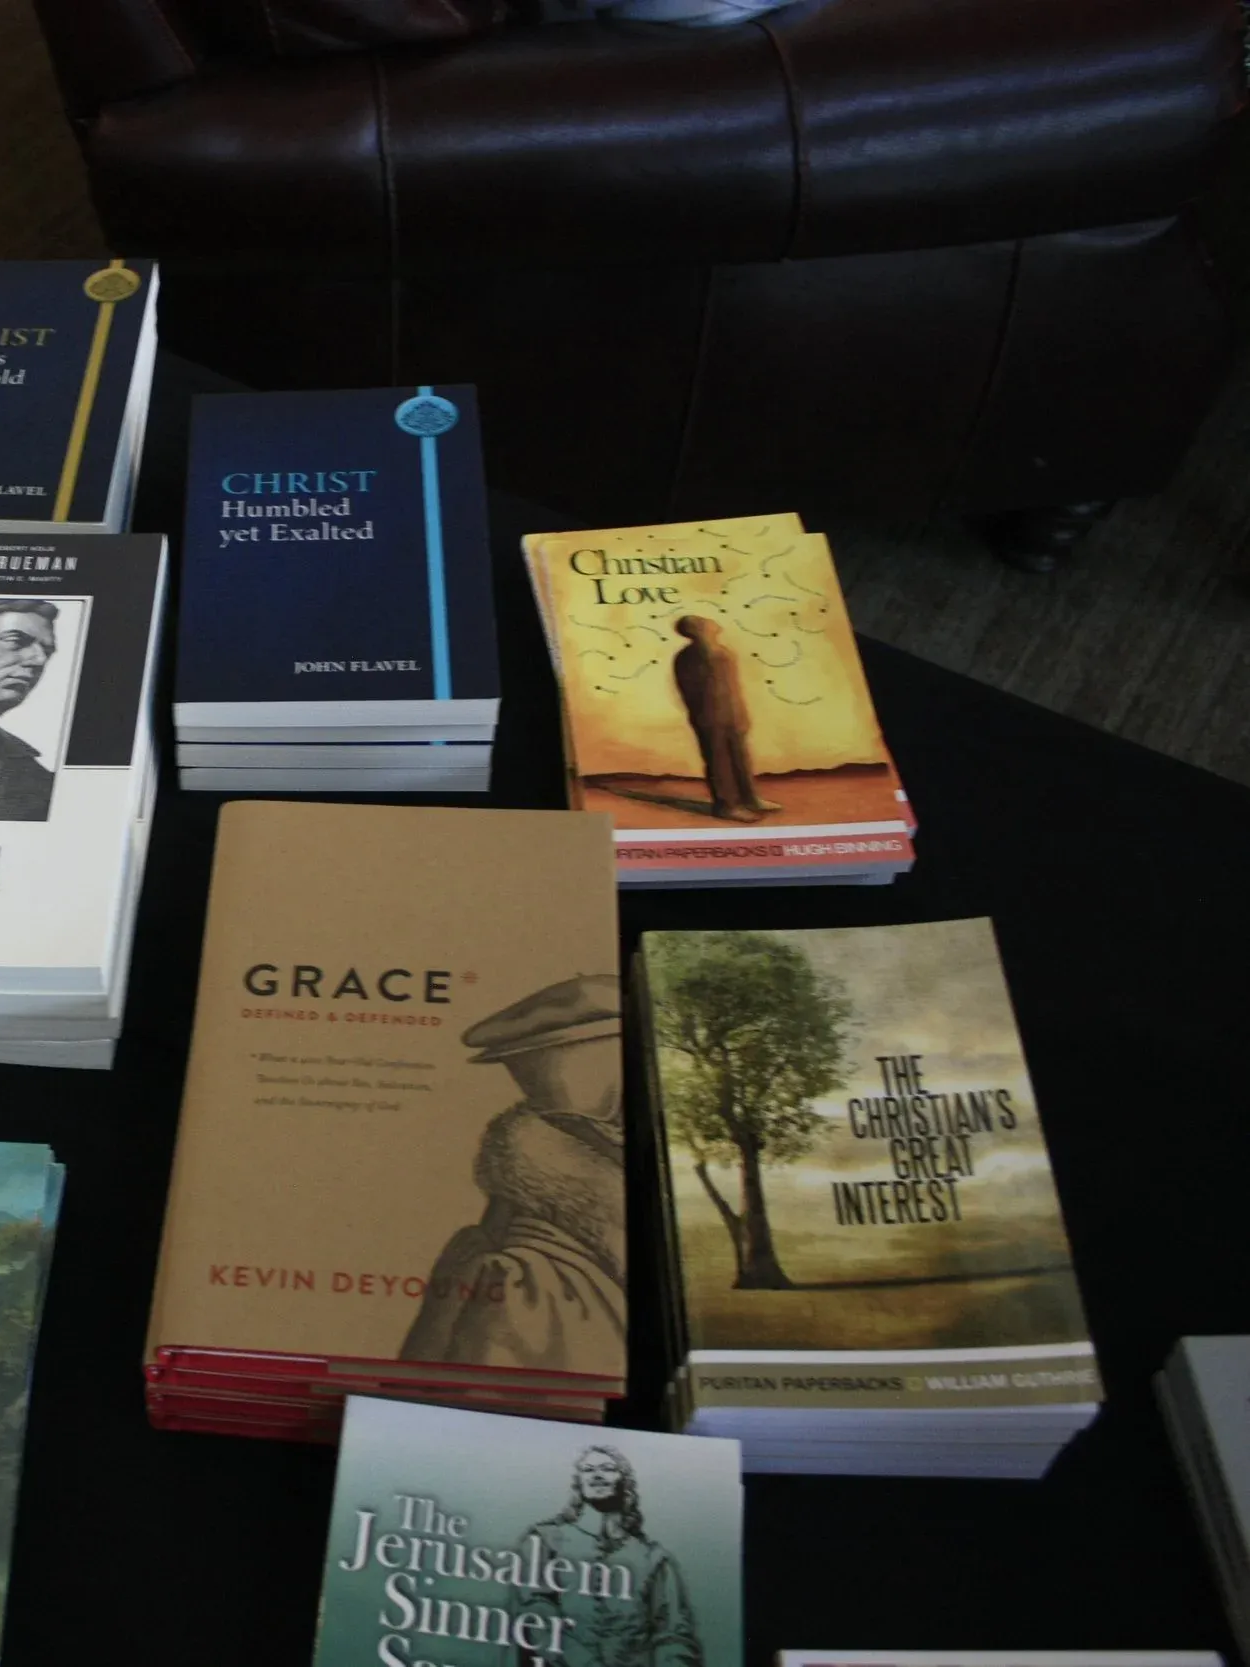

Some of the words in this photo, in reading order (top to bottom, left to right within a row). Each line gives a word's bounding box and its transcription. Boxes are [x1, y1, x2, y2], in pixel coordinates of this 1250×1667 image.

[220, 469, 378, 495] CHRIST
[220, 497, 352, 519] Humbled
[218, 525, 261, 549] yet
[269, 520, 375, 542] Exalted
[569, 548, 723, 576] Christian
[593, 578, 681, 606] Love
[293, 661, 346, 674] JOHN
[349, 659, 421, 672] FLAVEL
[242, 963, 453, 1005] GRACE
[239, 1007, 321, 1022] DEFINED
[326, 1011, 337, 1024] &
[343, 1012, 444, 1027] DEFENDED
[875, 1054, 924, 1097] THE
[848, 1088, 1017, 1139] CHRISTIAN'S
[888, 1133, 976, 1181] GREAT
[831, 1178, 964, 1226] INTEREST
[209, 1264, 316, 1292] KEVIN
[699, 1376, 777, 1392] PURITAN
[782, 1376, 904, 1393] PAPERBACKS
[924, 1372, 1007, 1391] WILLIAM
[1012, 1368, 1096, 1389] GUTHRIE
[393, 1494, 469, 1538] The
[338, 1509, 635, 1601] Jerusalem
[378, 1571, 578, 1654] Sinner
